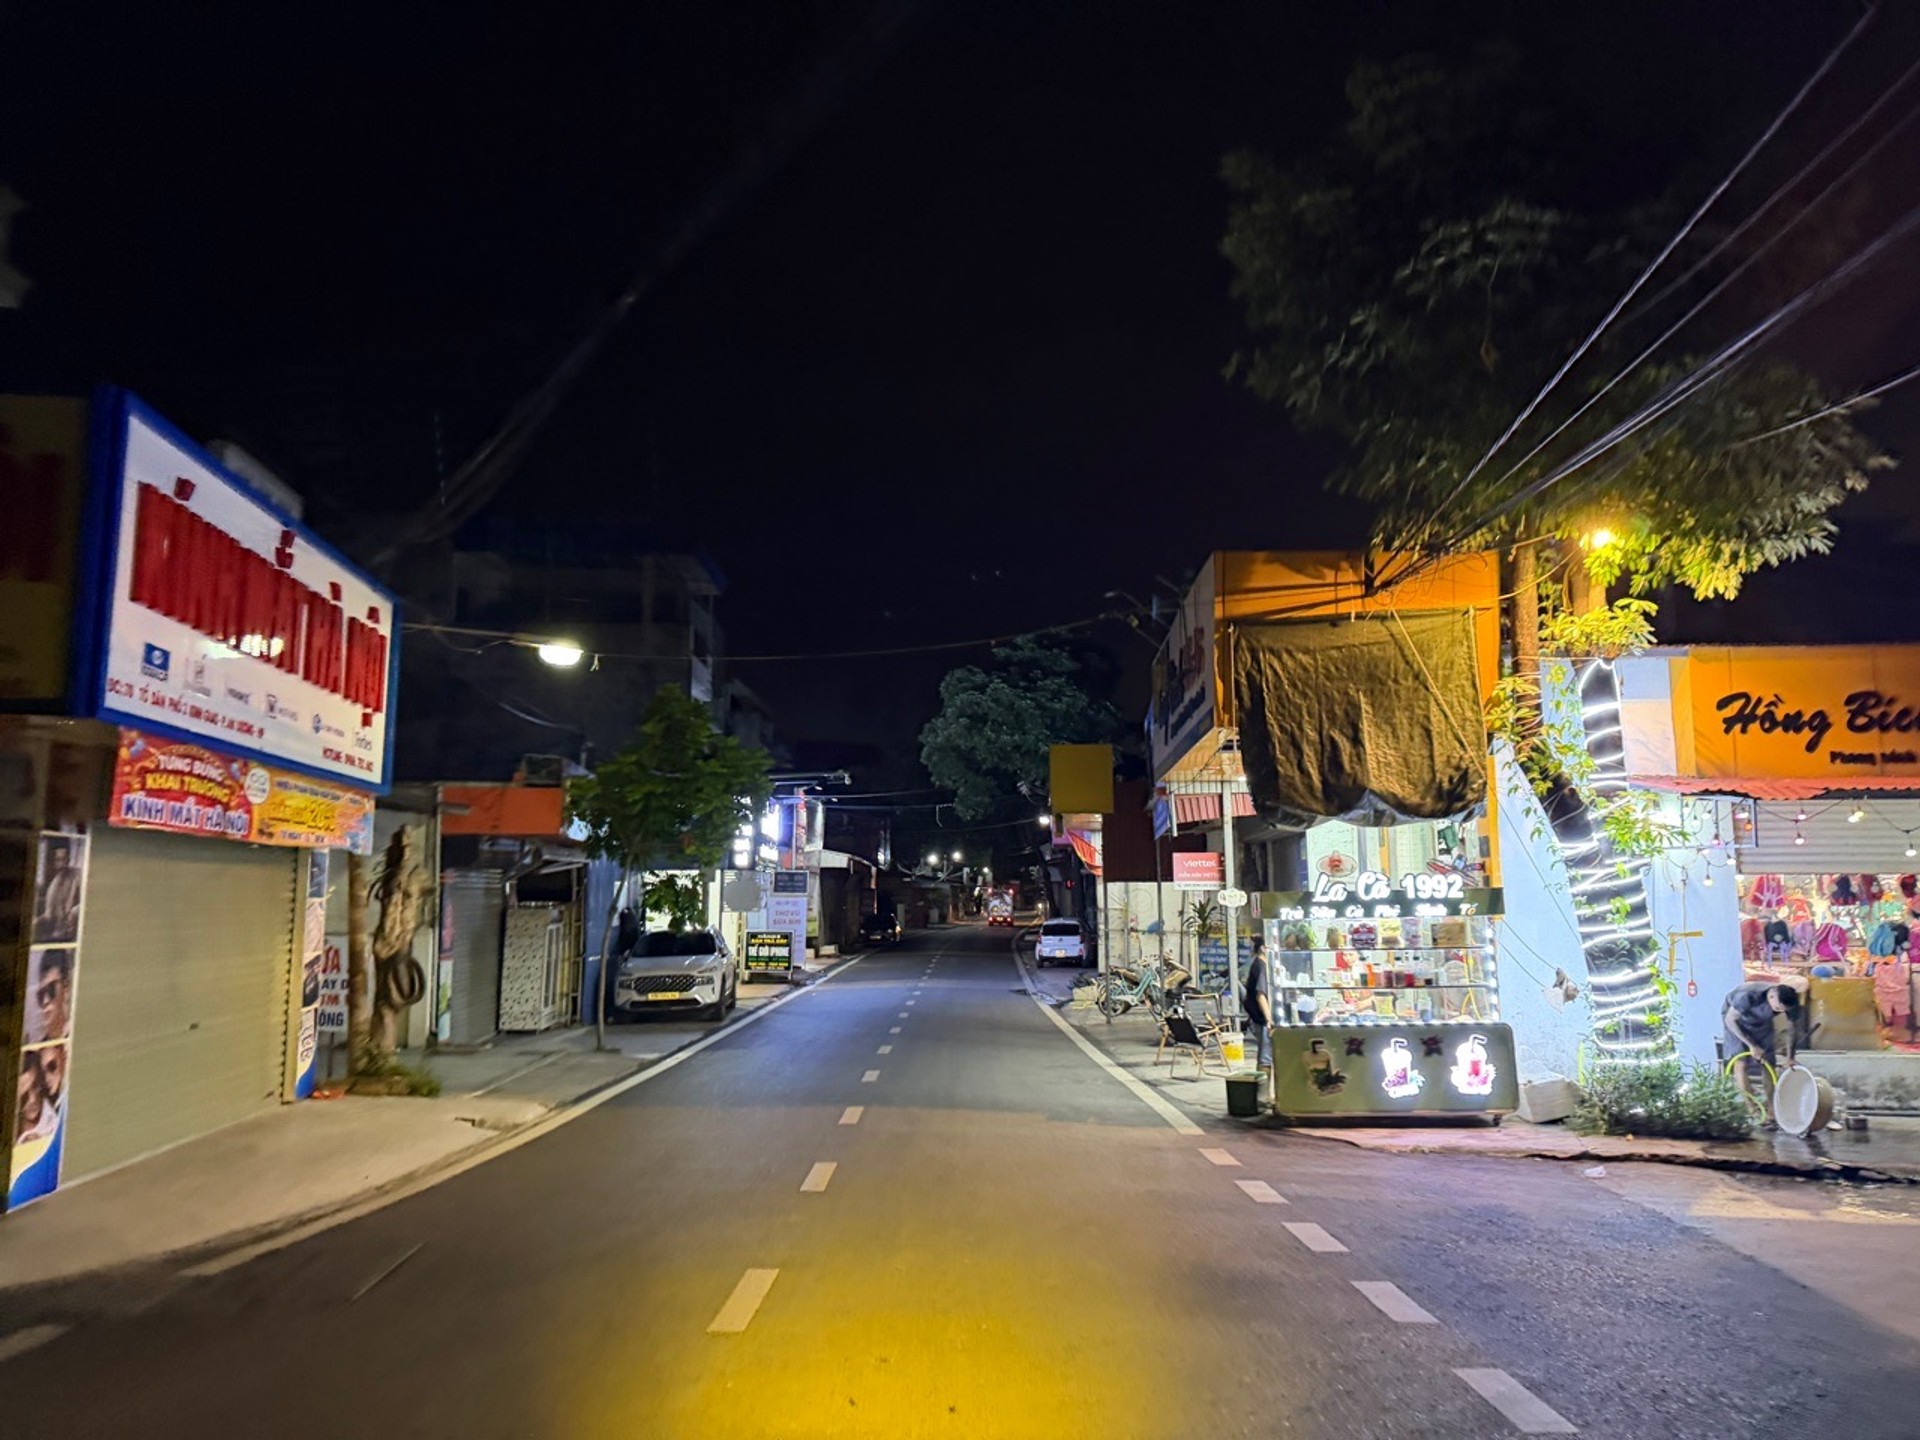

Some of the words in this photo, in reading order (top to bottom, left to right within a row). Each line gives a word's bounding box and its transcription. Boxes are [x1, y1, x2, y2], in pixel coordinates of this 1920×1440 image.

[1716, 691, 1833, 753] Hồng
[1844, 690, 1920, 734] Bíc
[145, 771, 181, 791] KHAI
[122, 792, 165, 822] KÍNH
[202, 804, 226, 833] HÀ
[1183, 859, 1217, 868] viettel
[1312, 872, 1348, 902] La
[1357, 871, 1391, 900] Cà
[1400, 873, 1464, 899] 1992
[1280, 905, 1305, 921] Trà
[1345, 903, 1365, 918] Cà
[1458, 903, 1479, 917] Tố
